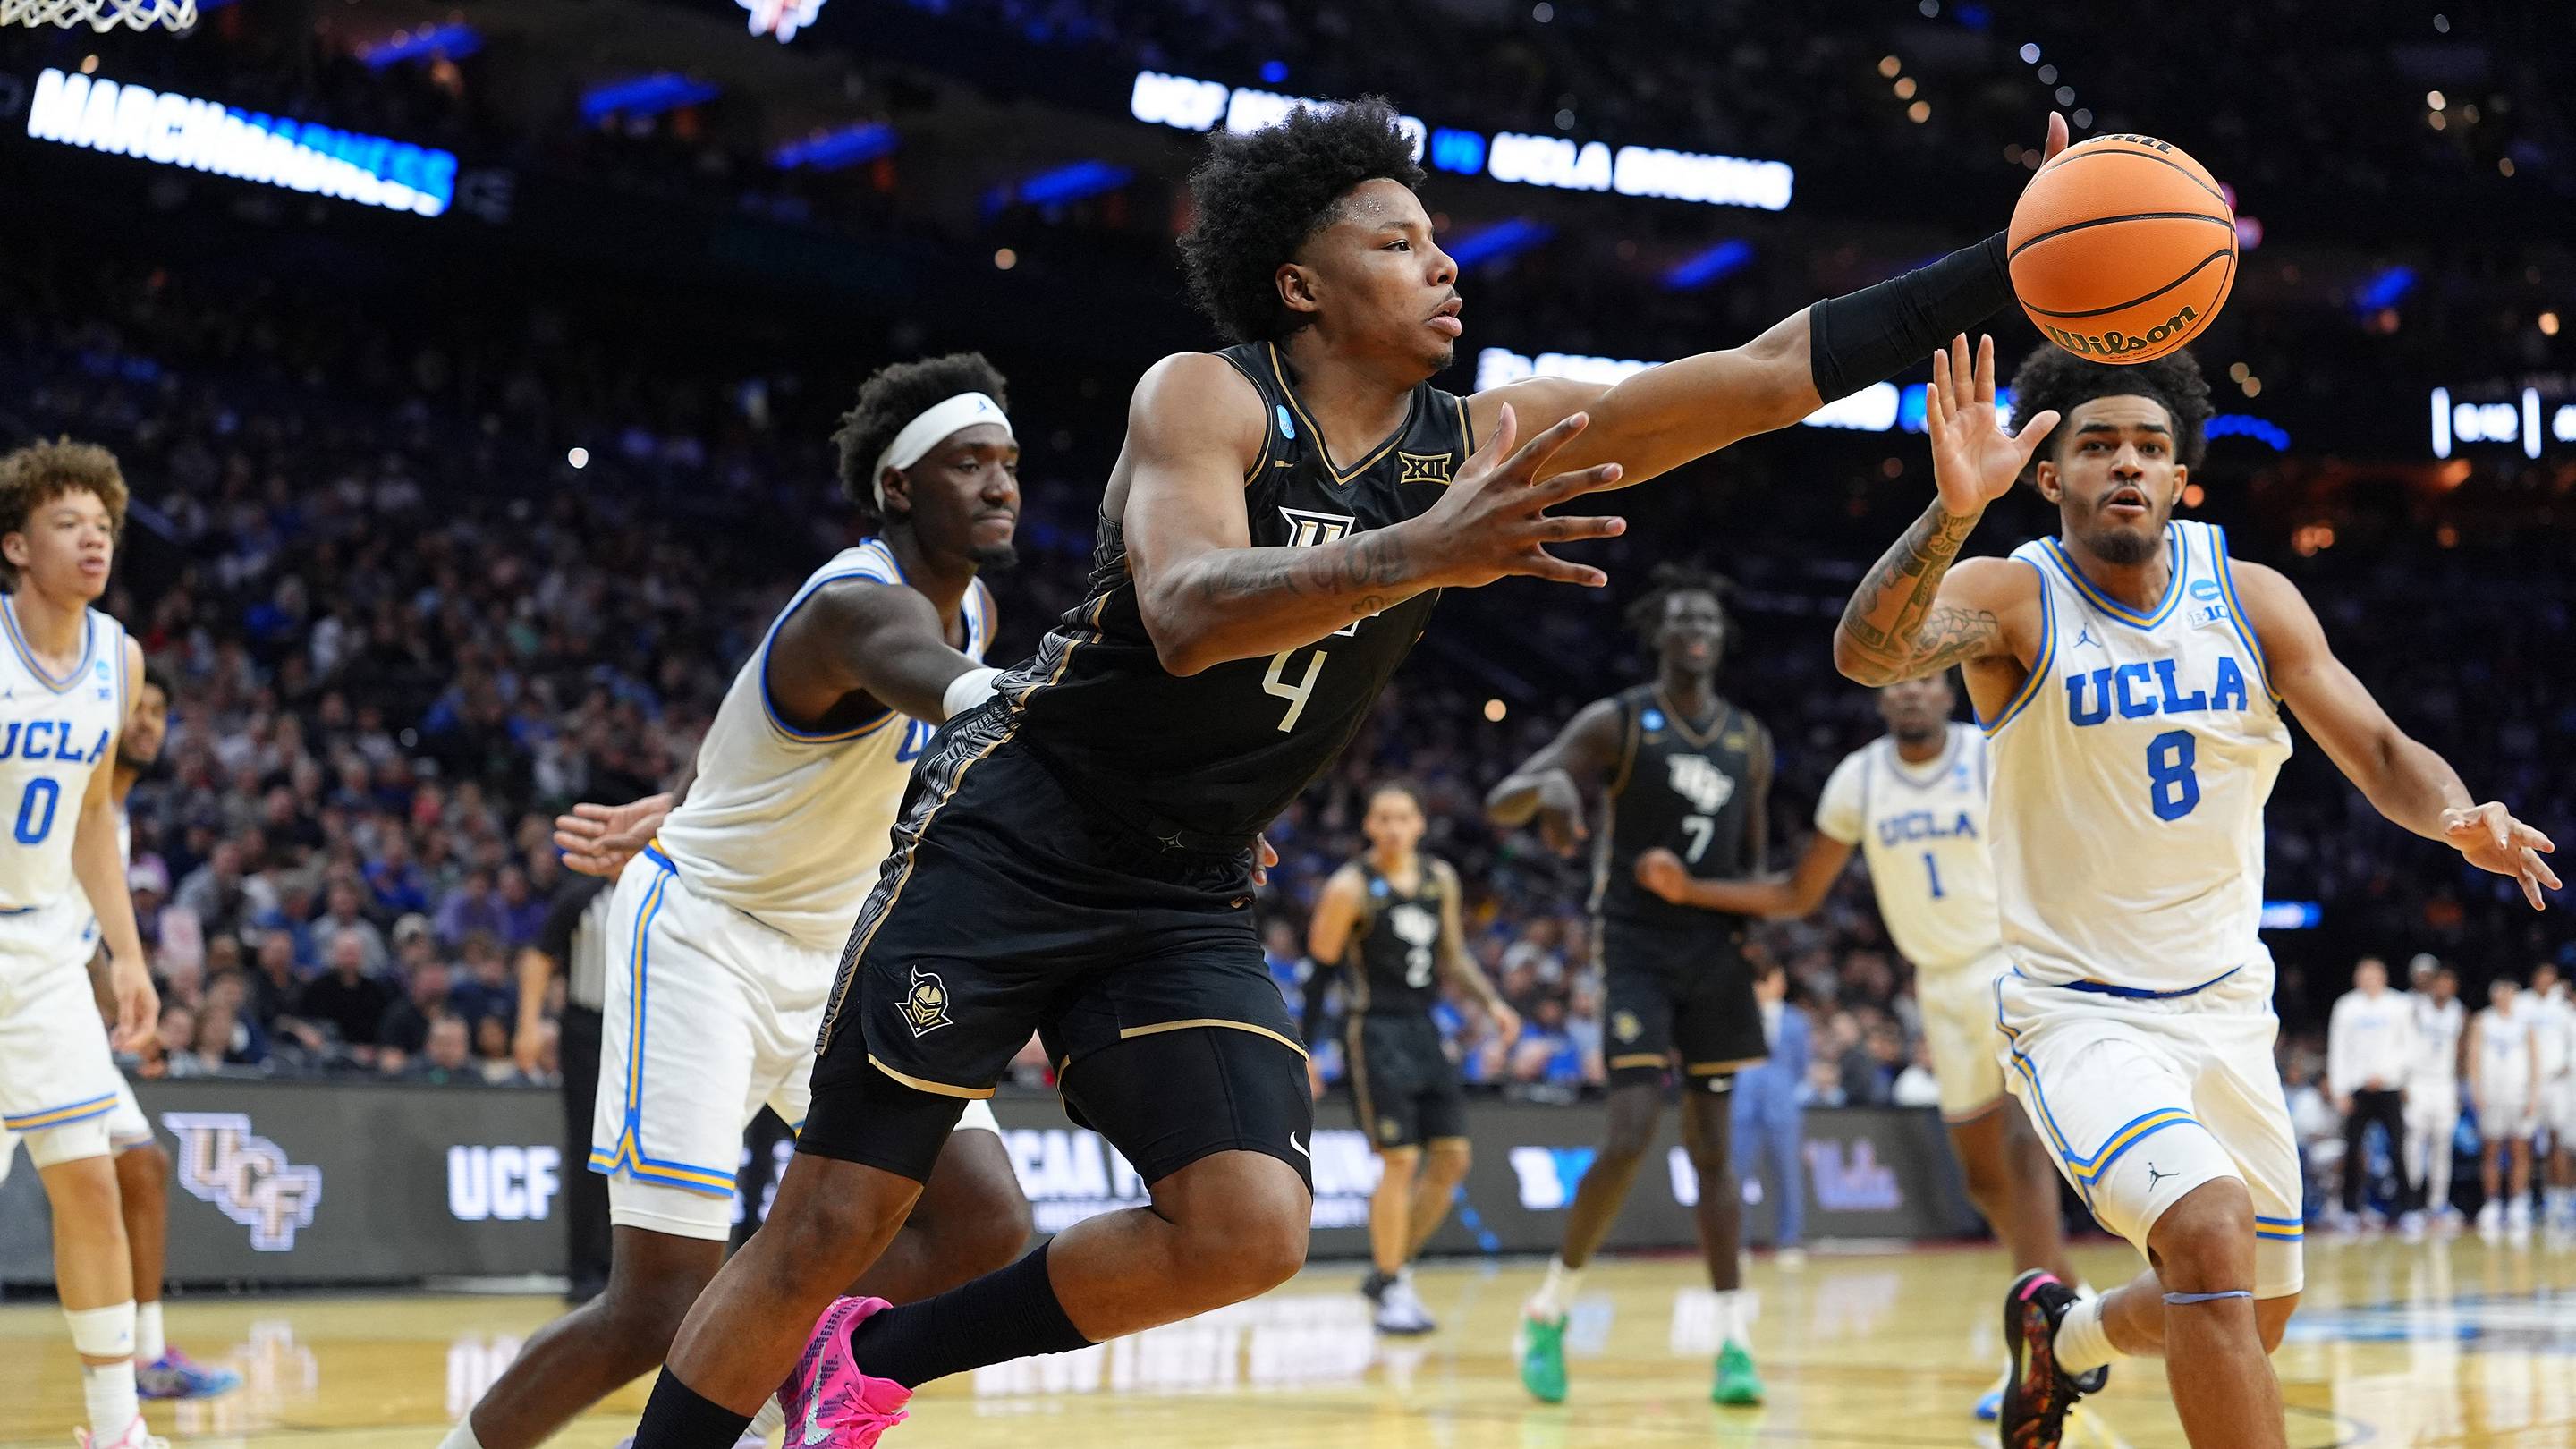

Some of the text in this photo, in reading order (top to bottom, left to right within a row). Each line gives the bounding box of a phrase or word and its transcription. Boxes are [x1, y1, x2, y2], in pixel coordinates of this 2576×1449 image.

[2045, 305, 2199, 355] Wilson
[1262, 648, 1328, 733] 4
[2066, 657, 2248, 726] UCLA
[2147, 729, 2200, 821] 8
[14, 777, 60, 844] 0
[1681, 815, 1716, 865] 7
[1877, 809, 1979, 847] UCLA
[1923, 852, 1945, 898] 1
[1404, 947, 1432, 988] 2
[161, 1112, 322, 1252] UCF
[448, 1145, 562, 1221] UCF
